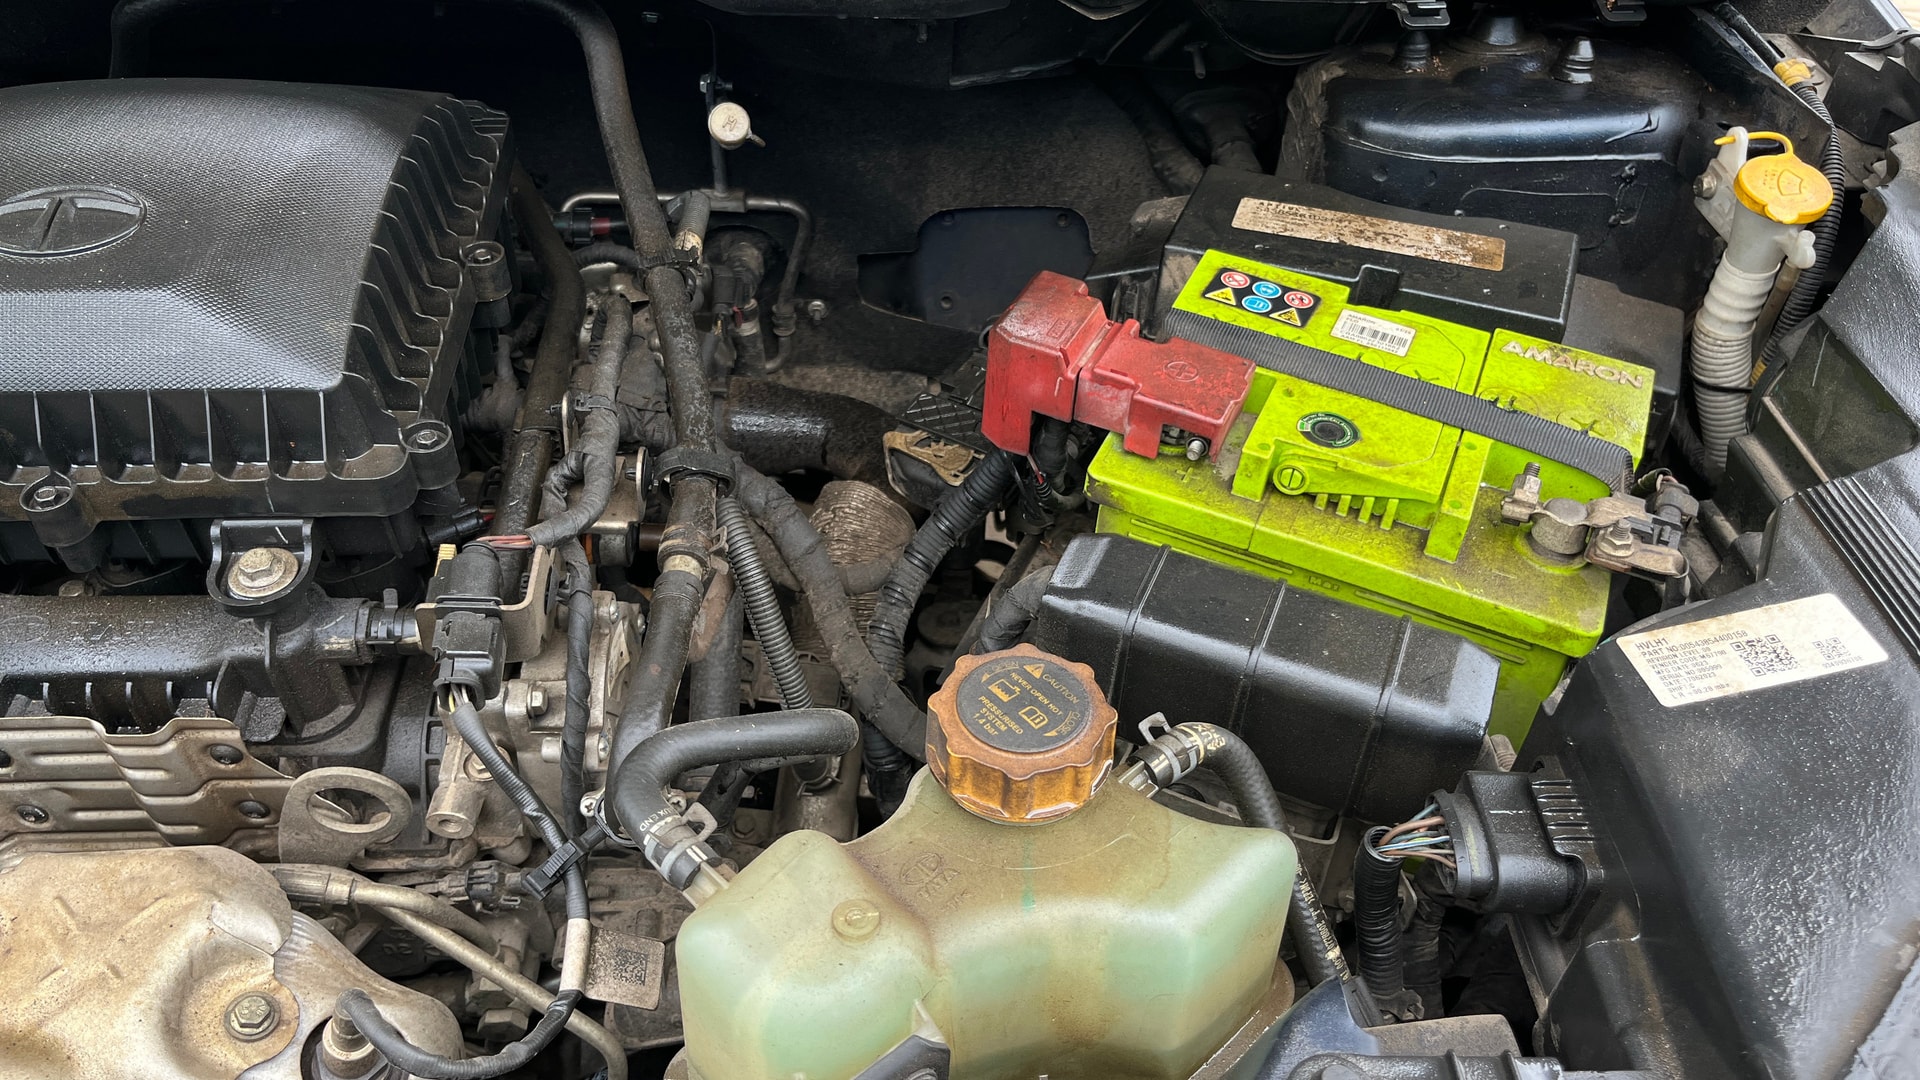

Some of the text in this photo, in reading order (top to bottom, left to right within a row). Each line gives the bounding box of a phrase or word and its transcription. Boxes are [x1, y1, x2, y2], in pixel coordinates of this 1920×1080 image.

[1501, 341, 1643, 389] AMARON
[1633, 636, 1670, 651] HVLH1
[1639, 647, 1665, 658] PART
[1010, 672, 1063, 716] NEVER OPEN HOT
[1042, 674, 1079, 704] CAUTION
[973, 713, 999, 736] 1.4 bar
[978, 695, 1023, 735] PRESSURISED
[980, 707, 1007, 732] SYSTEM
[639, 806, 674, 832] UX END
